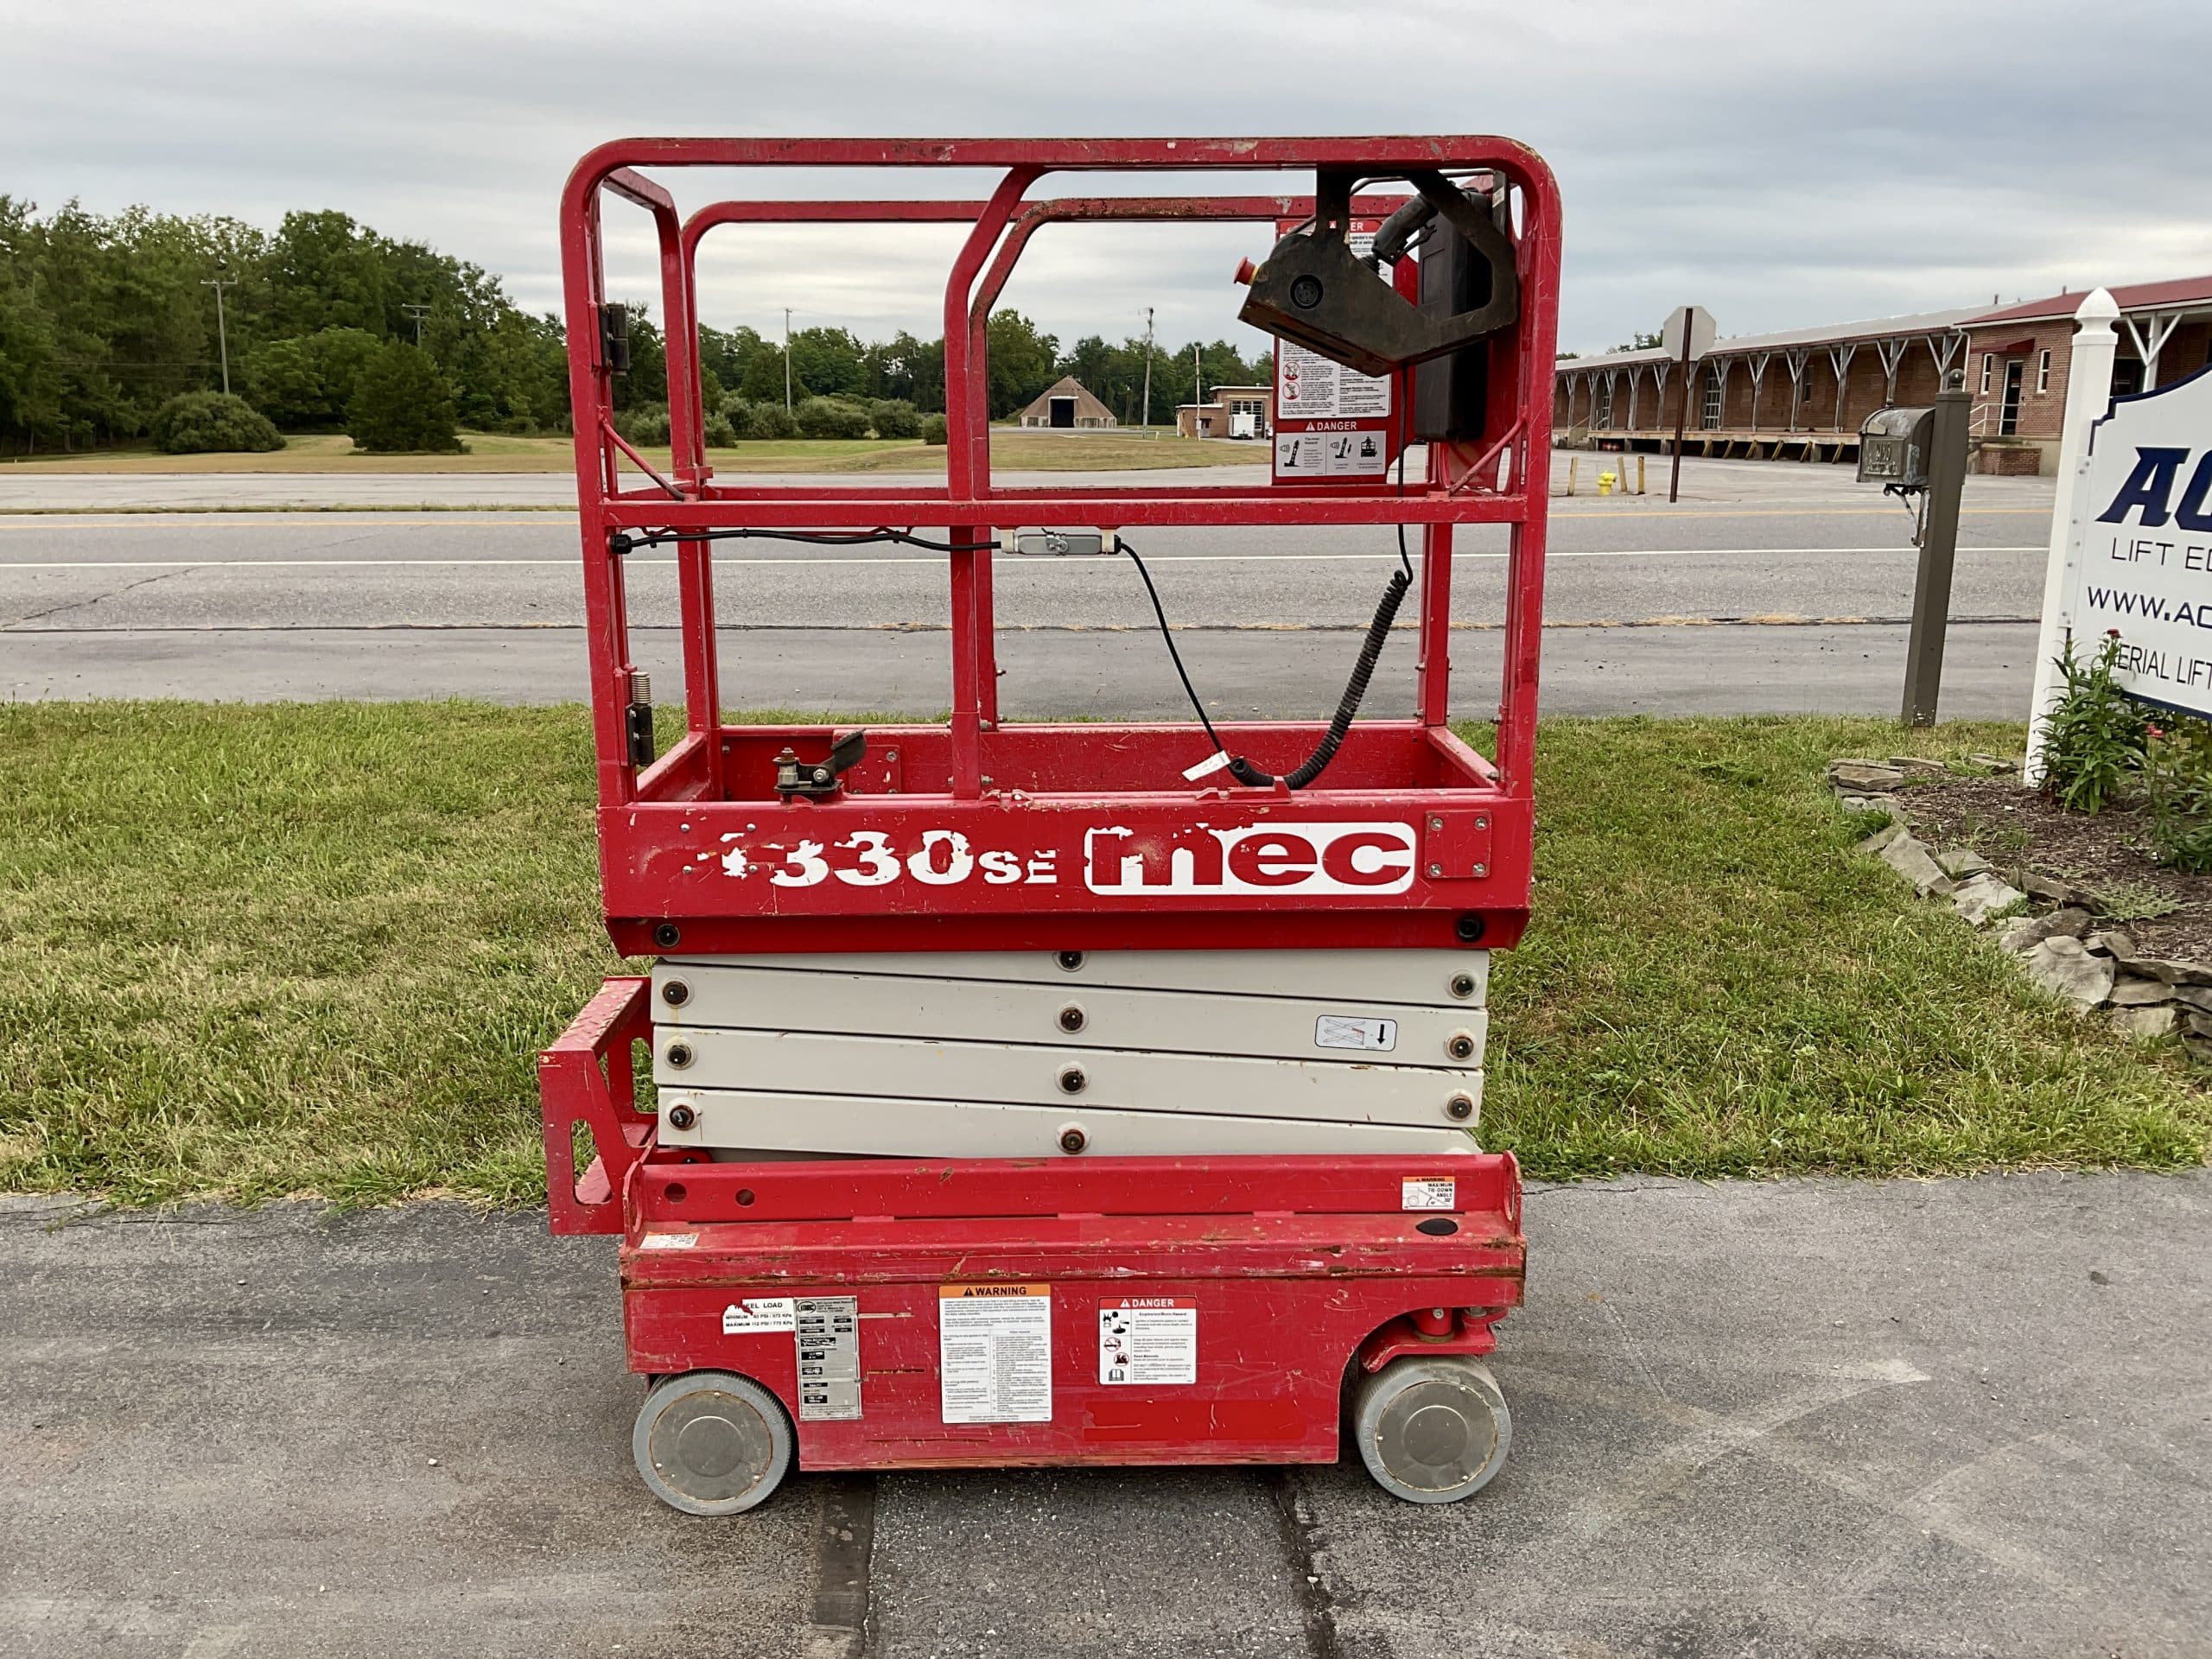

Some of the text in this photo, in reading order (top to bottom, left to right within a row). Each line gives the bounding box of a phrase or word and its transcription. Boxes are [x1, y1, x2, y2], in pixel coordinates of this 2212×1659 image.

[1317, 422, 1357, 431] DANGER
[2112, 537, 2174, 566] LIFT
[2114, 644, 2170, 680] ERIAL
[1091, 832, 1411, 886] mec
[976, 1287, 1027, 1296] WARNING
[1132, 1299, 1174, 1307] DANGER
